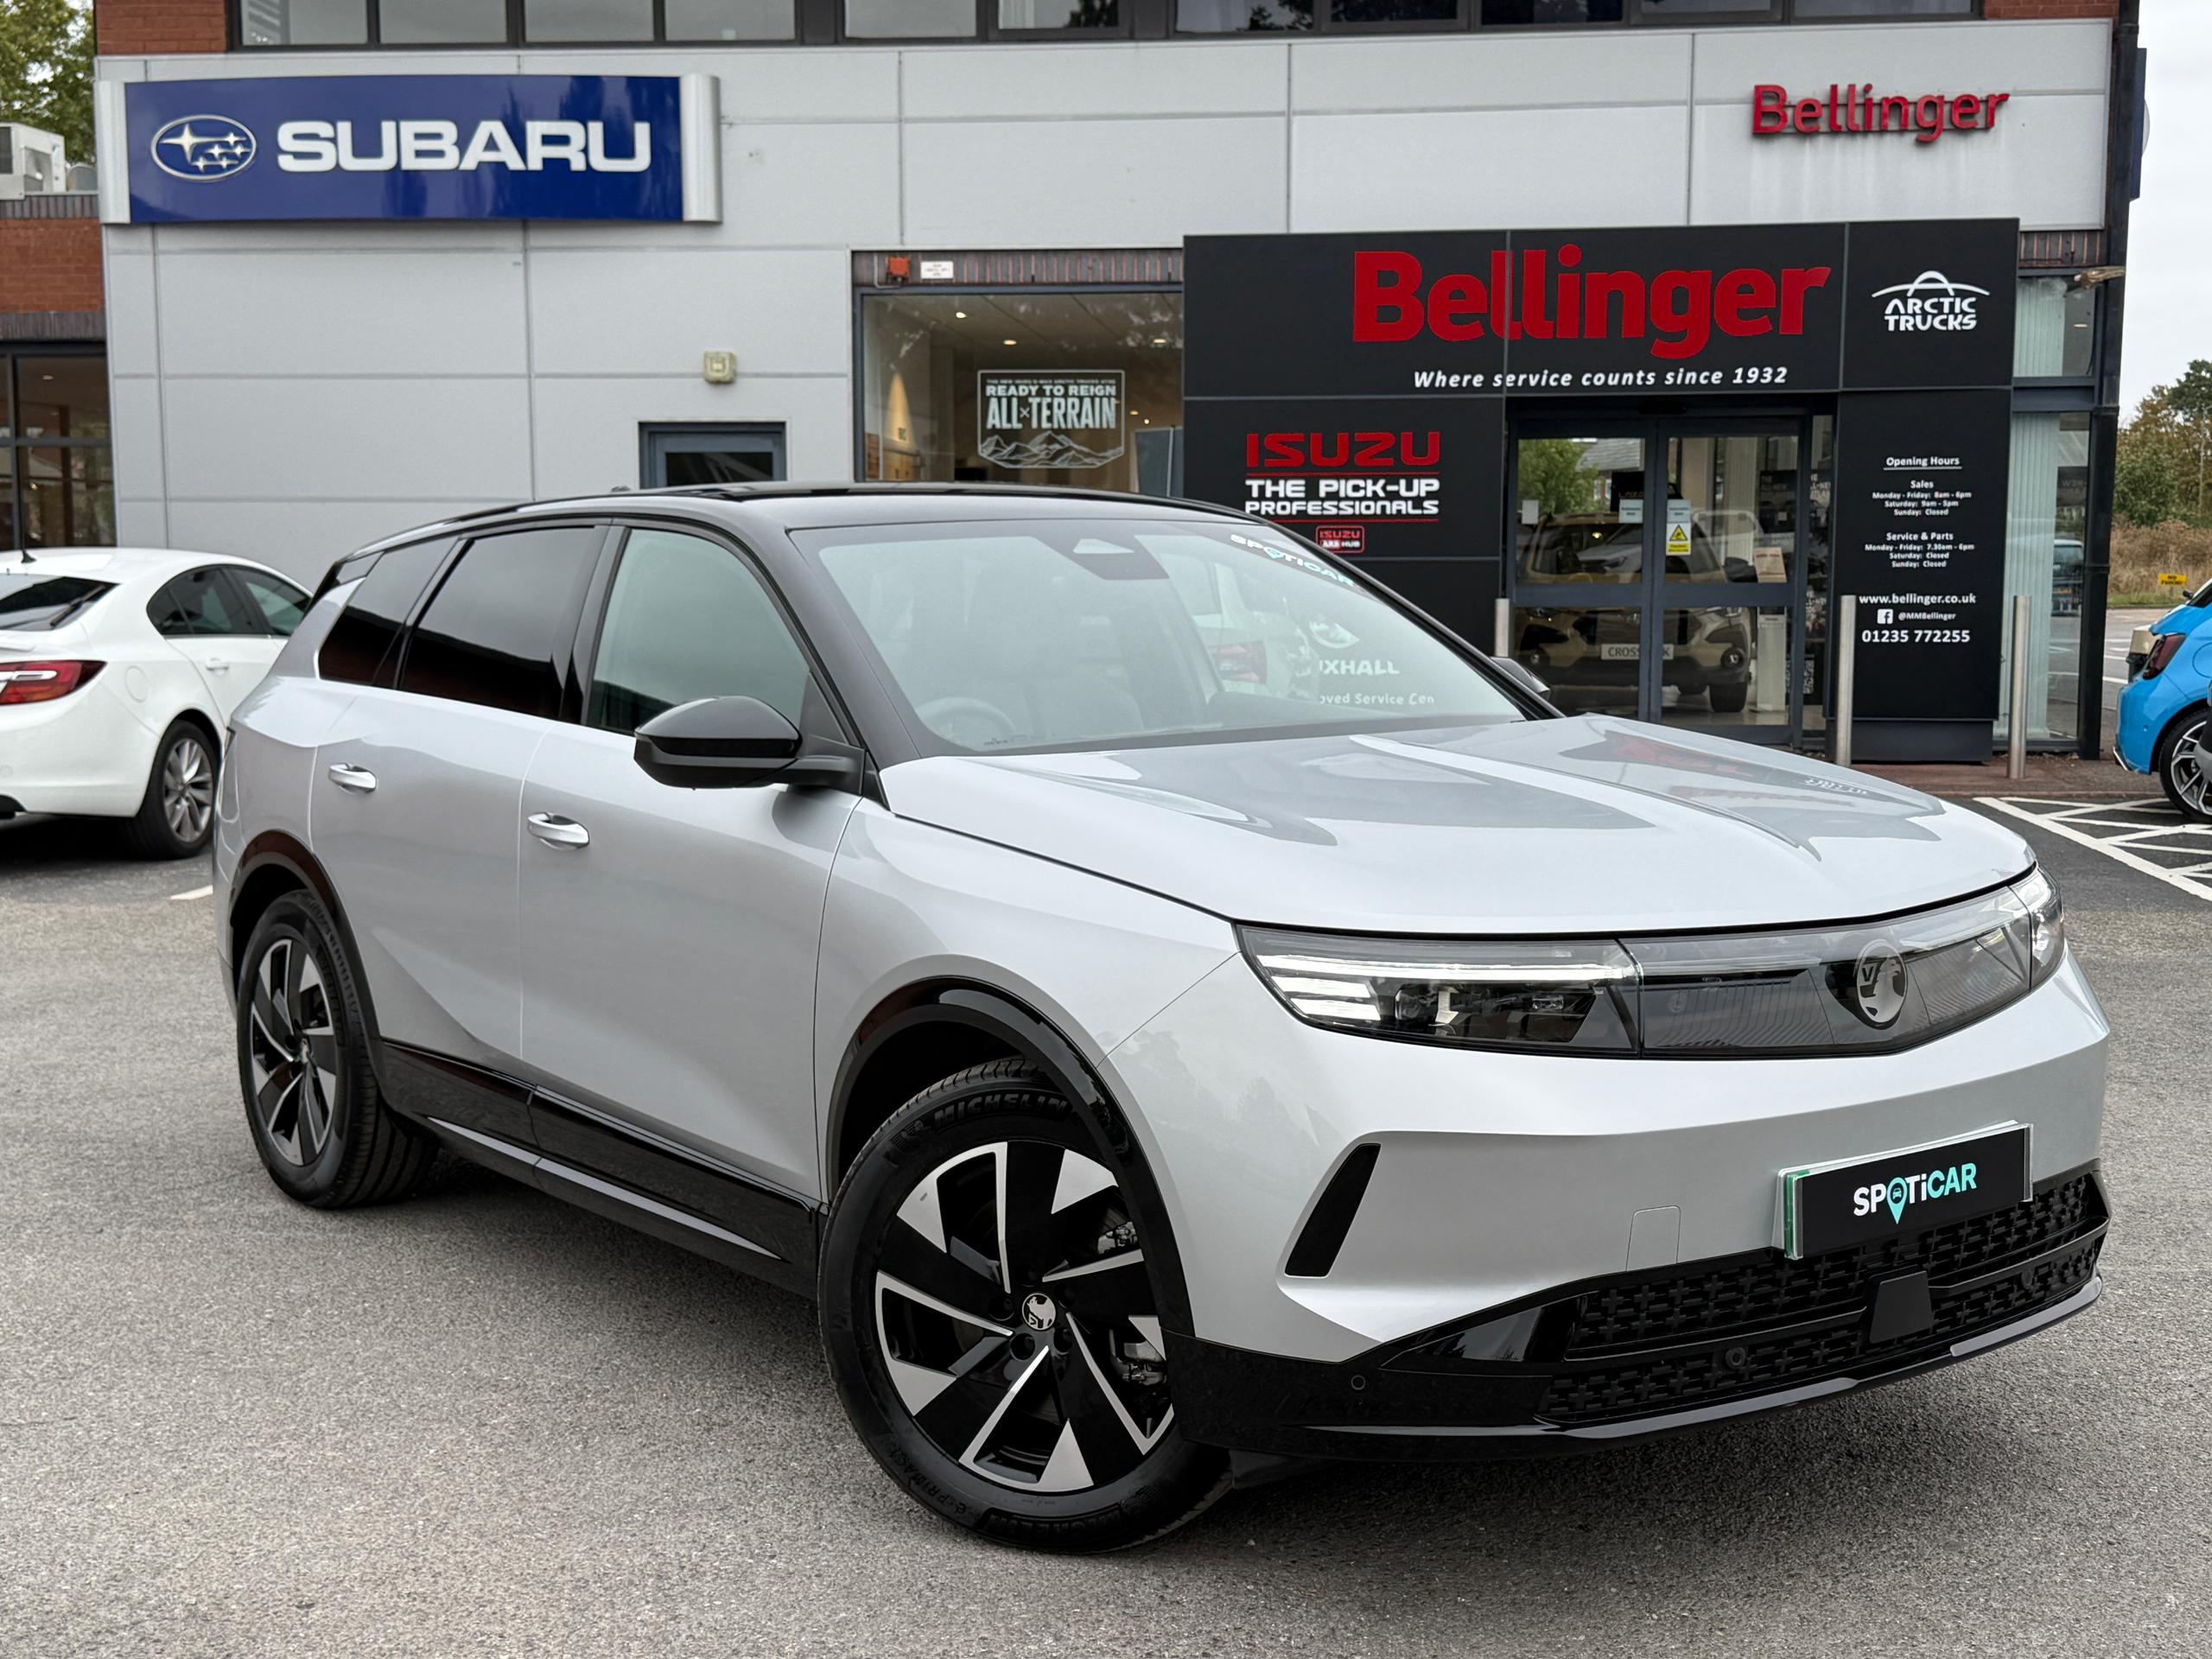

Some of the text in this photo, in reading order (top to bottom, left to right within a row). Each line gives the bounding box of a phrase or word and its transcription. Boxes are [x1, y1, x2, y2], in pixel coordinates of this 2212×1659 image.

[1751, 83, 2010, 143] Bellinger
[276, 119, 652, 174] SUBARU
[1352, 244, 1833, 359] Bellinger
[1884, 296, 1977, 315] ARCTIC
[1884, 314, 1978, 332] TRUCKS
[1413, 366, 1789, 389] Where service counts since 1932
[985, 385, 1116, 397] READY TO REIGN
[1246, 431, 1441, 467] ISUZU
[1885, 456, 1960, 467] Opening Hours
[1245, 478, 1440, 498] THE PICK-UP
[1910, 480, 1935, 488] Sales
[1955, 491, 1972, 499] 6pm
[1245, 499, 1440, 515] PROFESSIONALS
[1319, 531, 1361, 539] ISUZU
[1886, 531, 1954, 541] Service & Parts
[1859, 593, 1976, 606] www.bellinger.co.uk
[1897, 612, 1956, 621] @MMBellinger
[1861, 629, 1971, 643] 01235 772255
[1355, 693, 1404, 705] Service
